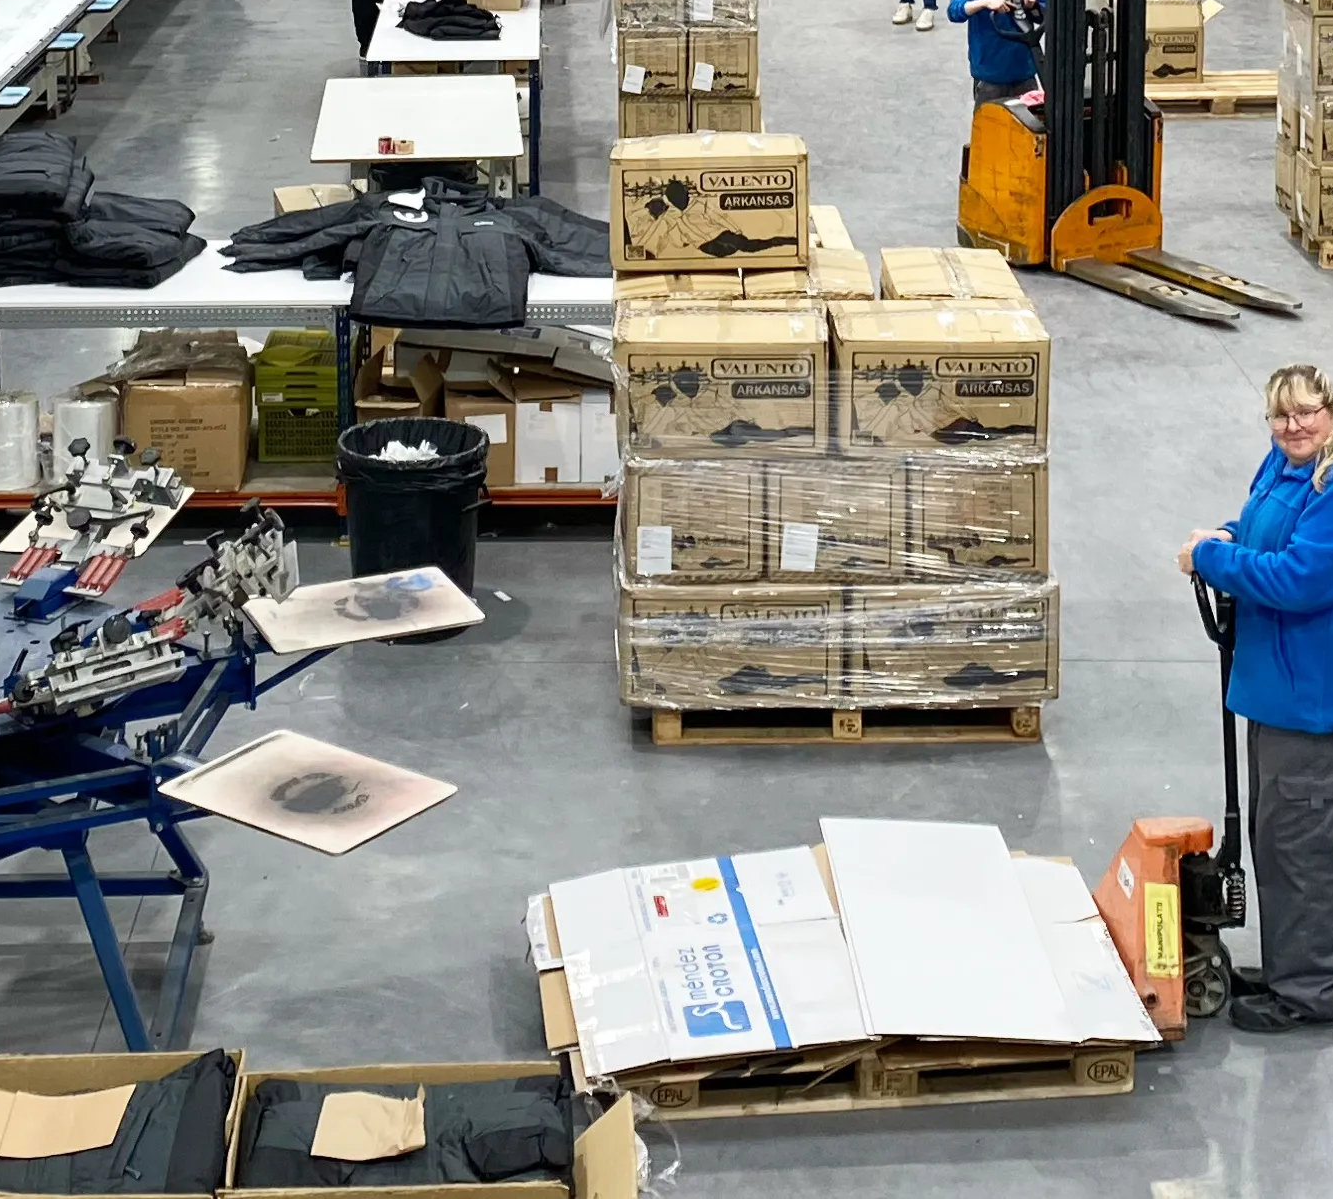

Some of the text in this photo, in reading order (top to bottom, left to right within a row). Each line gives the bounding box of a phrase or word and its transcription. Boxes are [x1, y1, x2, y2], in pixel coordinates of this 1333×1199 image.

[708, 173, 787, 189] VALENTO
[724, 194, 790, 210] ARKANSAS
[719, 360, 805, 376] VALENTO
[943, 359, 1029, 374] VALENTO
[736, 383, 806, 397] ARKANSAS
[960, 381, 1030, 396] ARKANSAS
[728, 607, 819, 620] VALENTO
[676, 947, 708, 1001] méndez
[1093, 1063, 1126, 1080] EPAL
